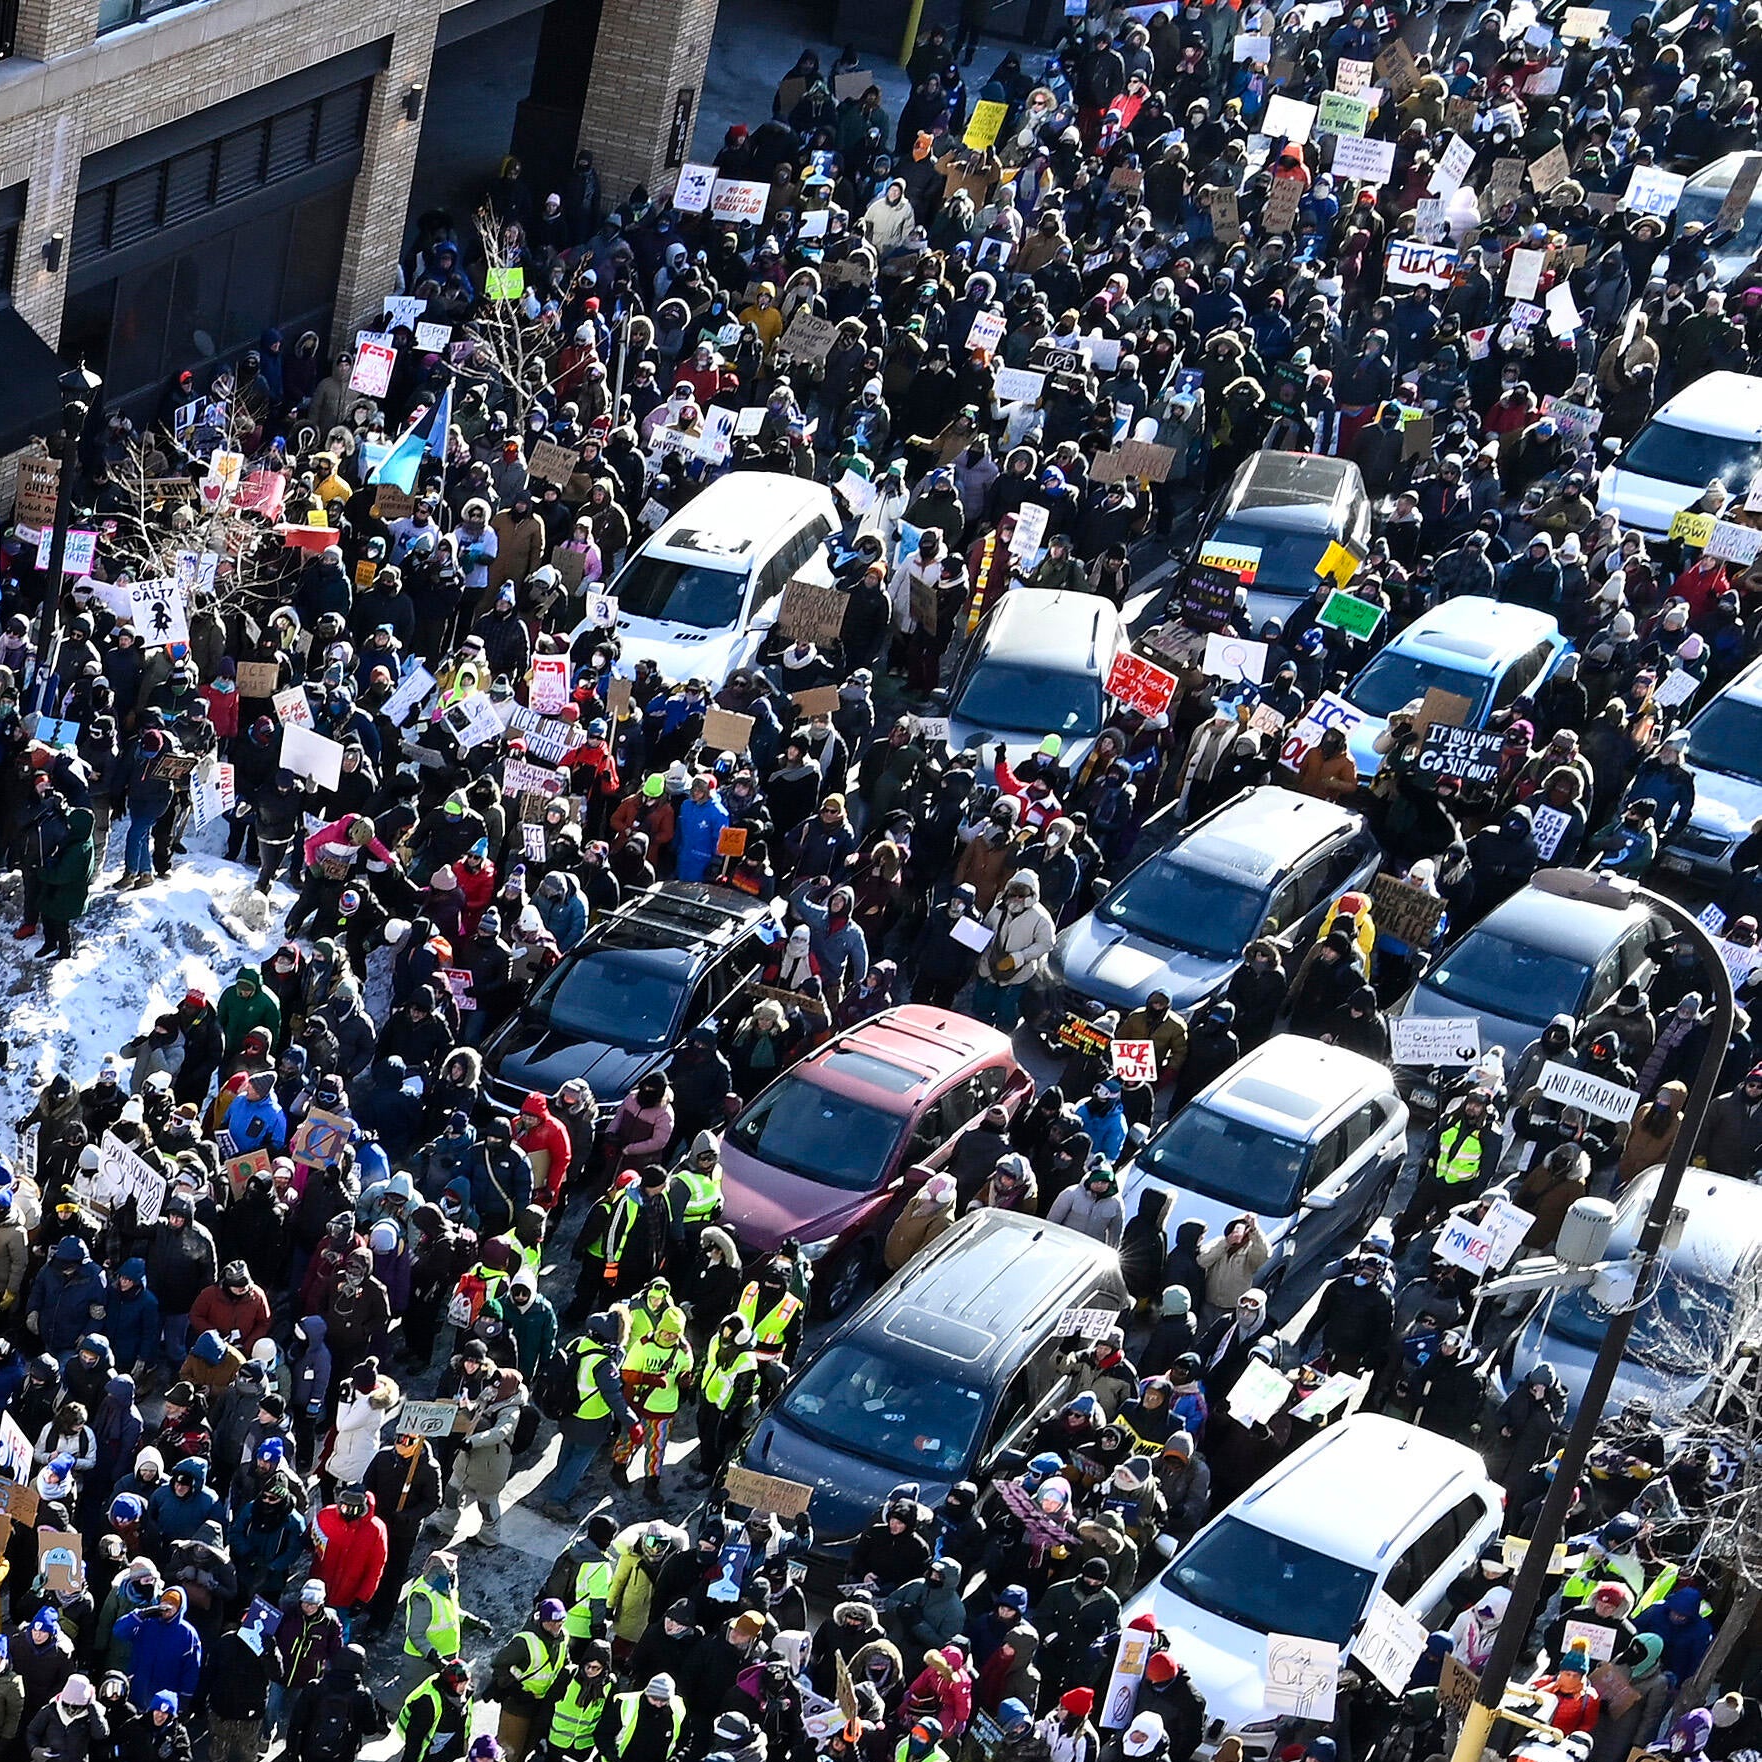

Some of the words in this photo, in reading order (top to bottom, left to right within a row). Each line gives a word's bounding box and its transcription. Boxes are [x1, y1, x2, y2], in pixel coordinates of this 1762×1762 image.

[133, 588, 173, 602] SALTY
[1118, 1043, 1149, 1064] ICE
[1117, 1063, 1154, 1078] OUT!
